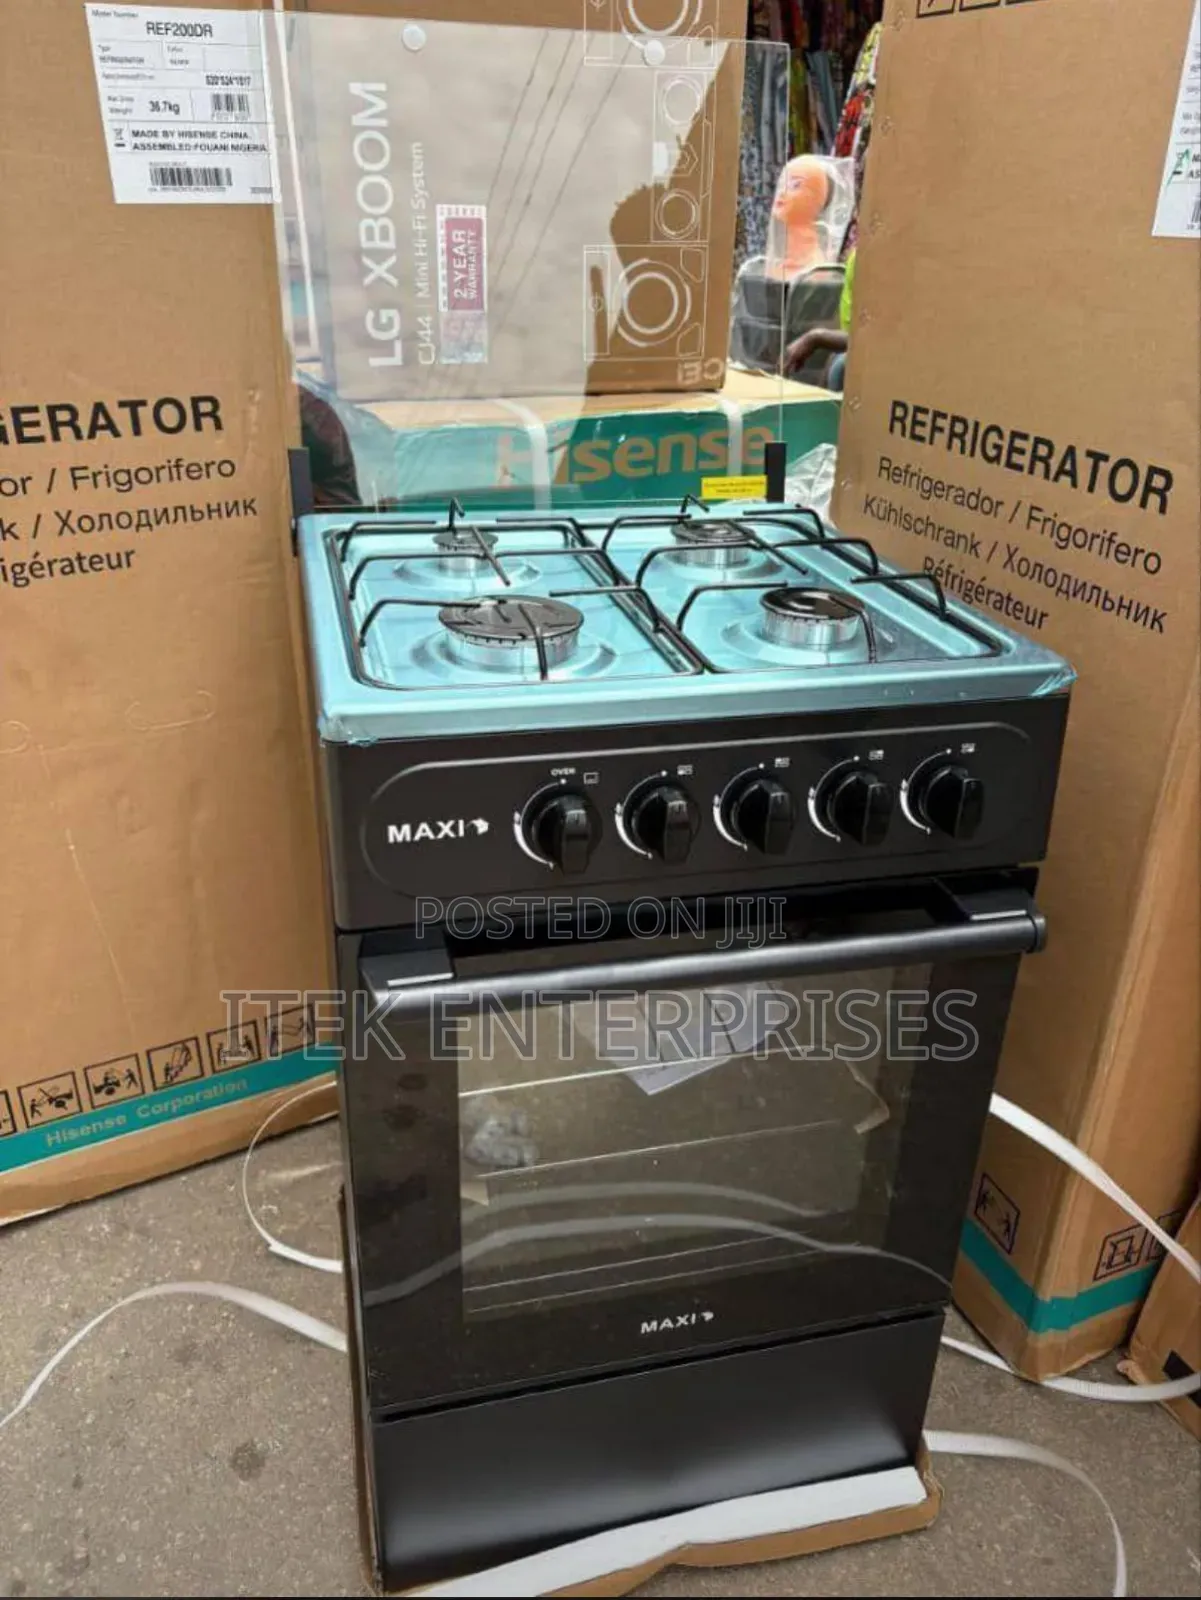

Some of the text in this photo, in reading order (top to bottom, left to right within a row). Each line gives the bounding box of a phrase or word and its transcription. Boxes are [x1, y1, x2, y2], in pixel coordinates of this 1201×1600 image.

[146, 21, 213, 38] REF200DR
[131, 129, 159, 138] MADE
[162, 129, 175, 138] BY
[410, 141, 429, 209] System
[349, 82, 404, 367] LG XBOOM
[413, 252, 431, 299] Mini
[452, 229, 469, 301] 2 YEAR
[0, 395, 223, 445] ERATOR
[70, 457, 236, 493] Frigorifero
[888, 400, 1174, 515] REFRIGERATOR
[54, 497, 257, 536] Холодильник
[877, 456, 1004, 523] Refrigerador
[1026, 505, 1162, 576] Frigorifero
[862, 493, 981, 559] Kühlschrank
[1002, 543, 1168, 634] Холодильник
[921, 555, 1049, 631] Réfrigérateur
[551, 766, 576, 777] OVEN
[388, 818, 465, 844] MAXI
[45, 1076, 249, 1147] Hisense Corporation
[641, 1312, 697, 1334] MAXI
